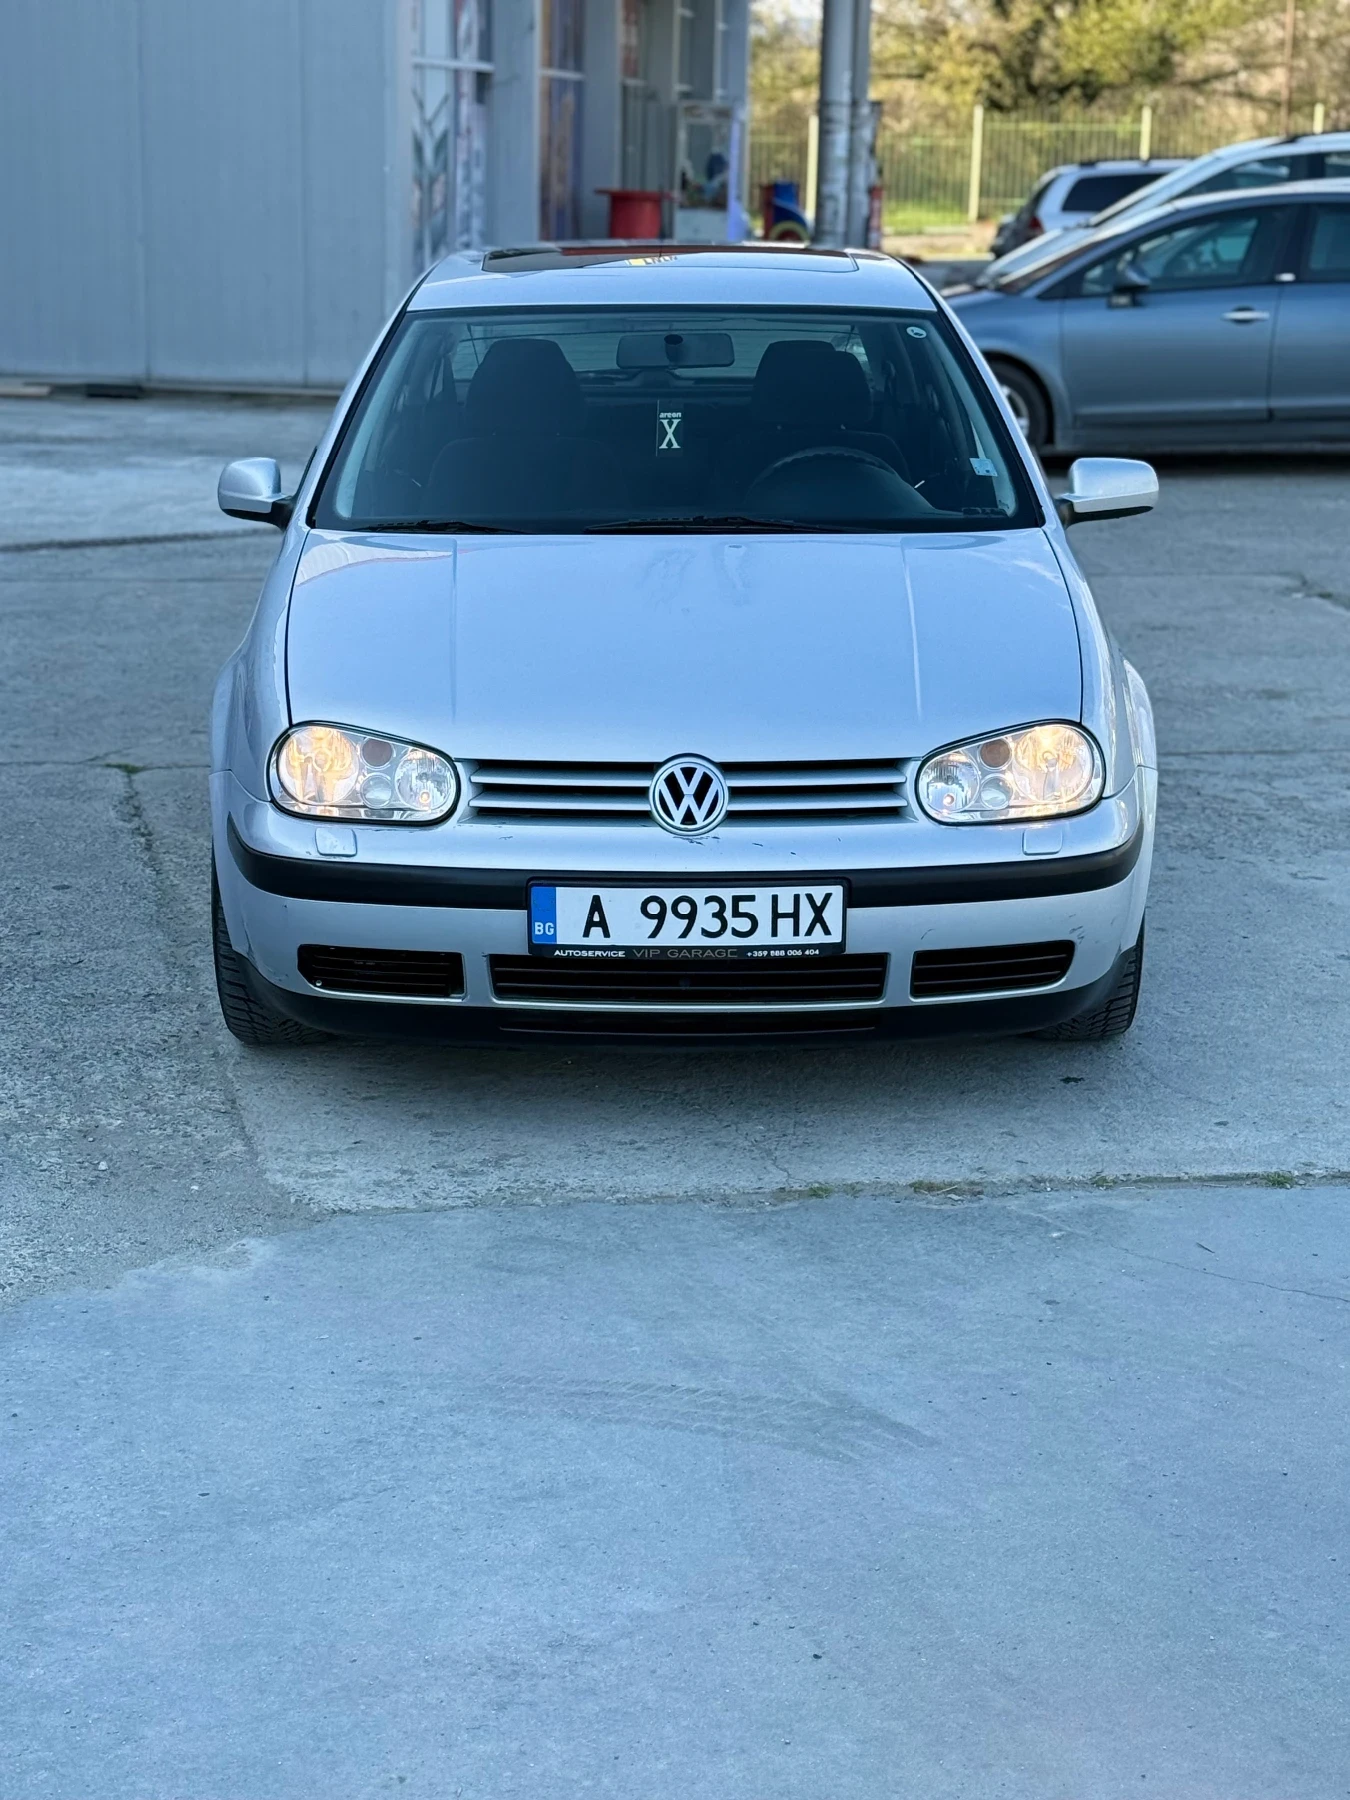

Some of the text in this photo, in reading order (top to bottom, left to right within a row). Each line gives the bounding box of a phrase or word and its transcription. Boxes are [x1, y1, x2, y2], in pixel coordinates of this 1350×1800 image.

[659, 418, 682, 449] X
[657, 762, 720, 830] VW
[534, 921, 555, 936] BG
[582, 892, 833, 939] A 9935 HX
[553, 949, 626, 958] AUTOSERVICE
[632, 948, 661, 958] VIP
[667, 948, 738, 958] GARAGE
